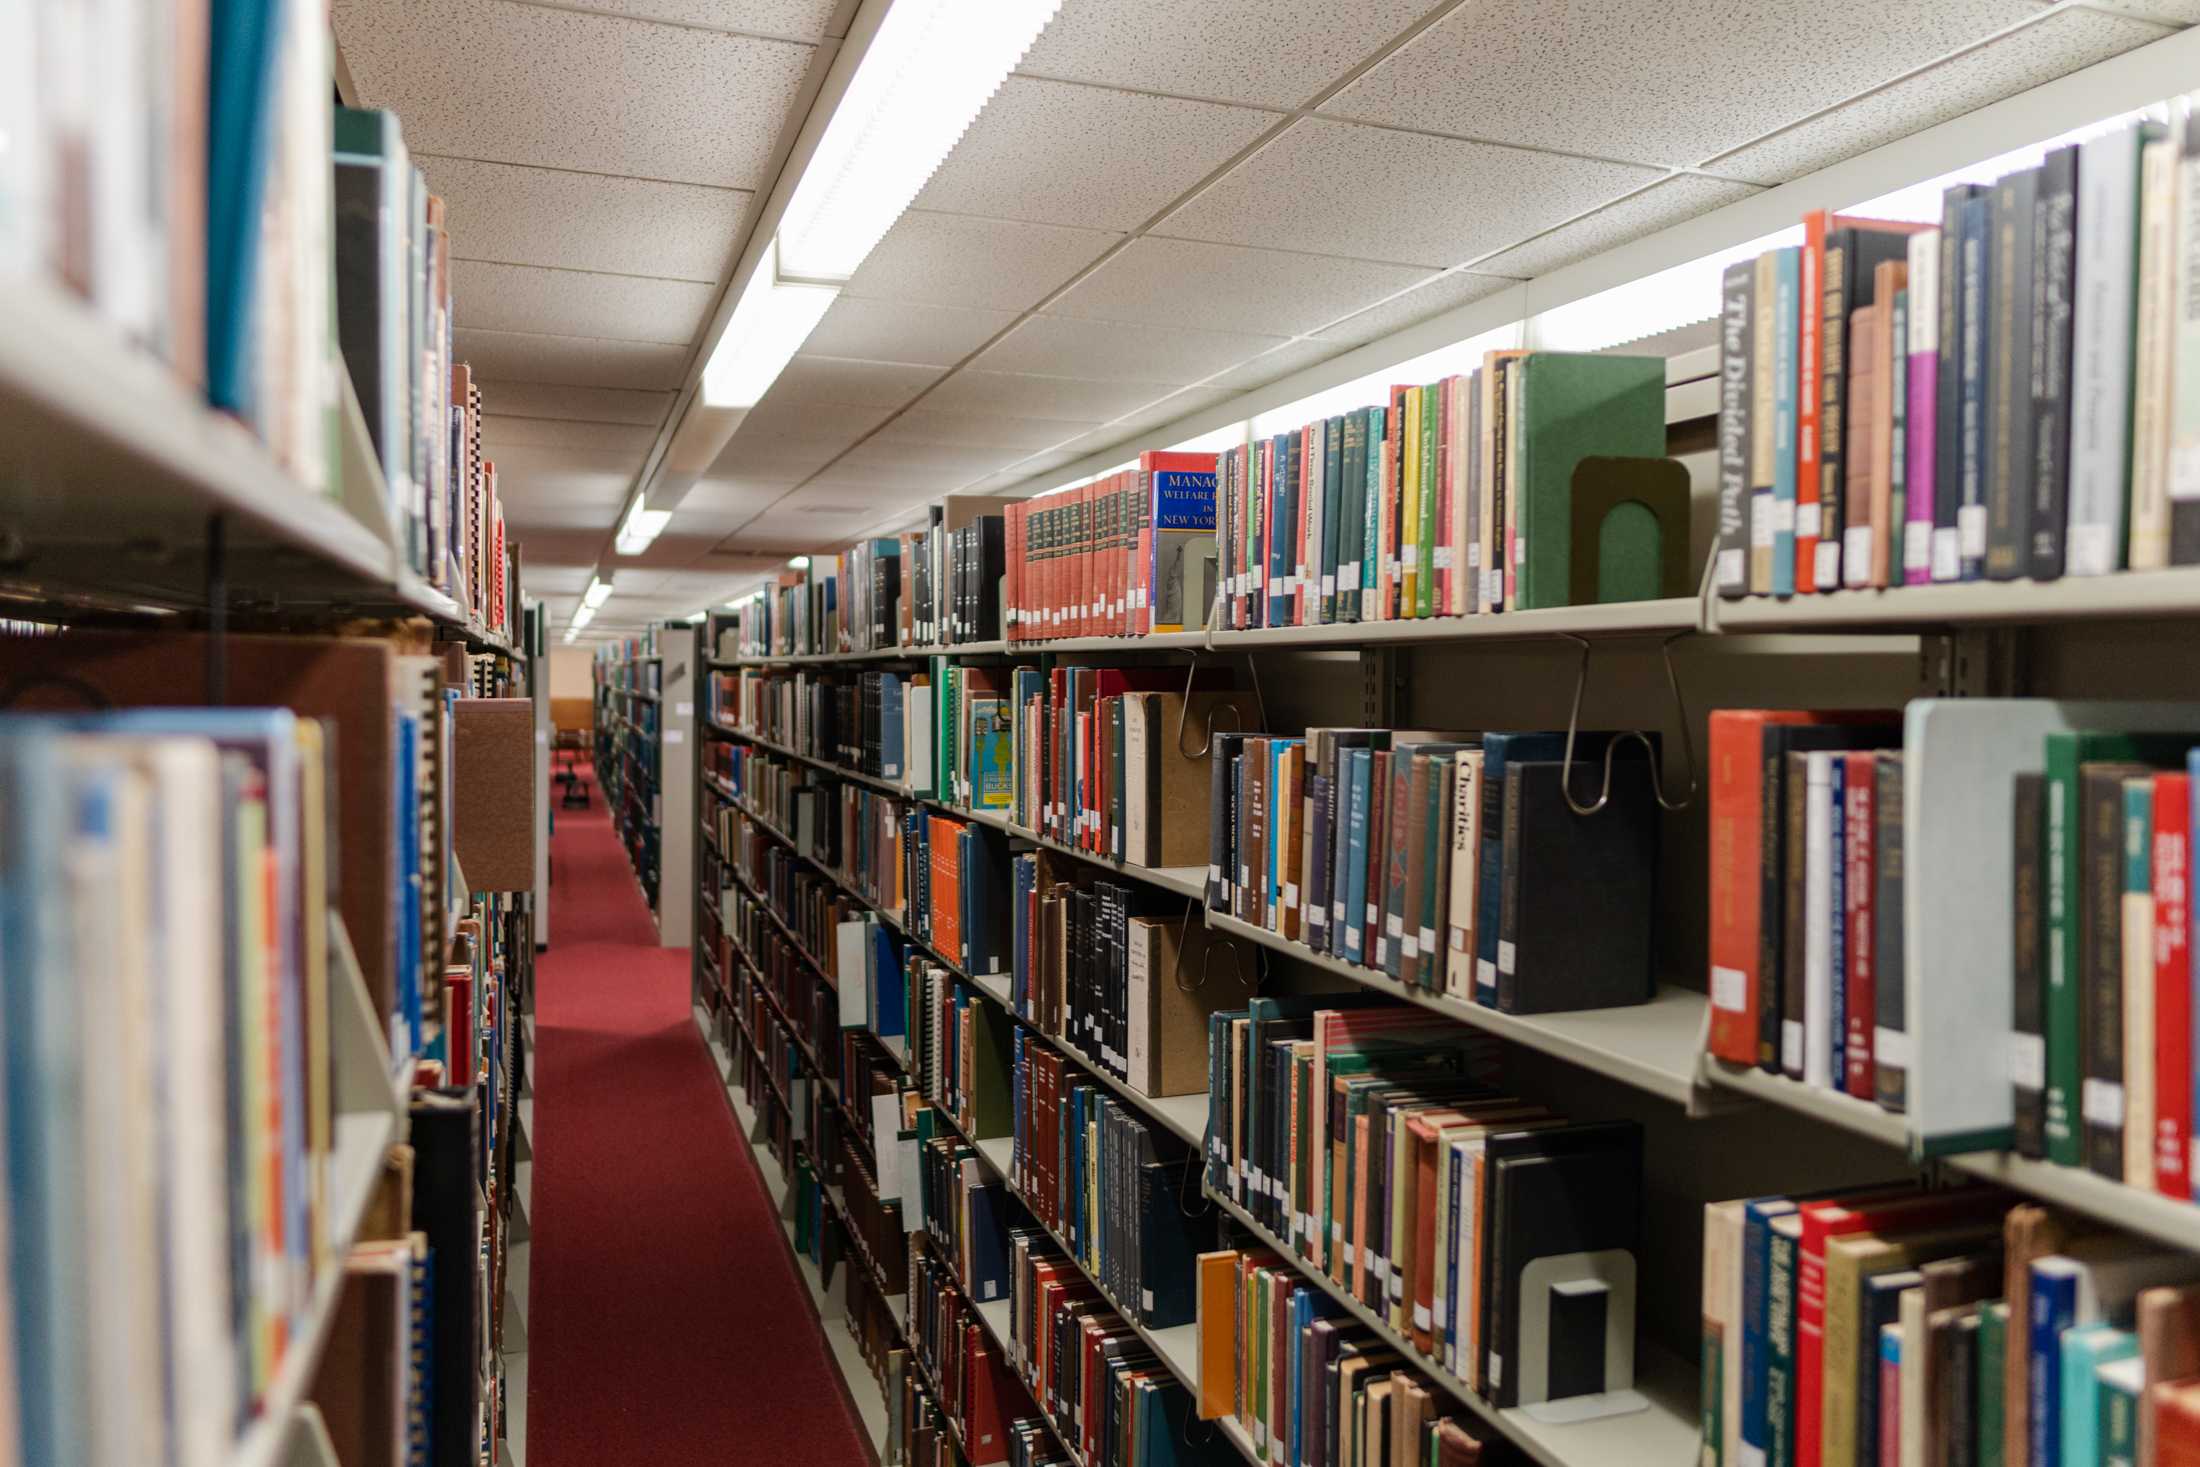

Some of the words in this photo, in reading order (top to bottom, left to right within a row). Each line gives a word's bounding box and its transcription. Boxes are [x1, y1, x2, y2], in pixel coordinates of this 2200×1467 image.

[1726, 293, 1748, 350] The
[1722, 355, 1748, 465] Divided
[1163, 490, 1211, 500] WELFARE
[1163, 515, 1189, 525] NEW
[1203, 505, 1213, 513] IN
[1722, 471, 1745, 536] Path
[1456, 761, 1472, 852] Charities
